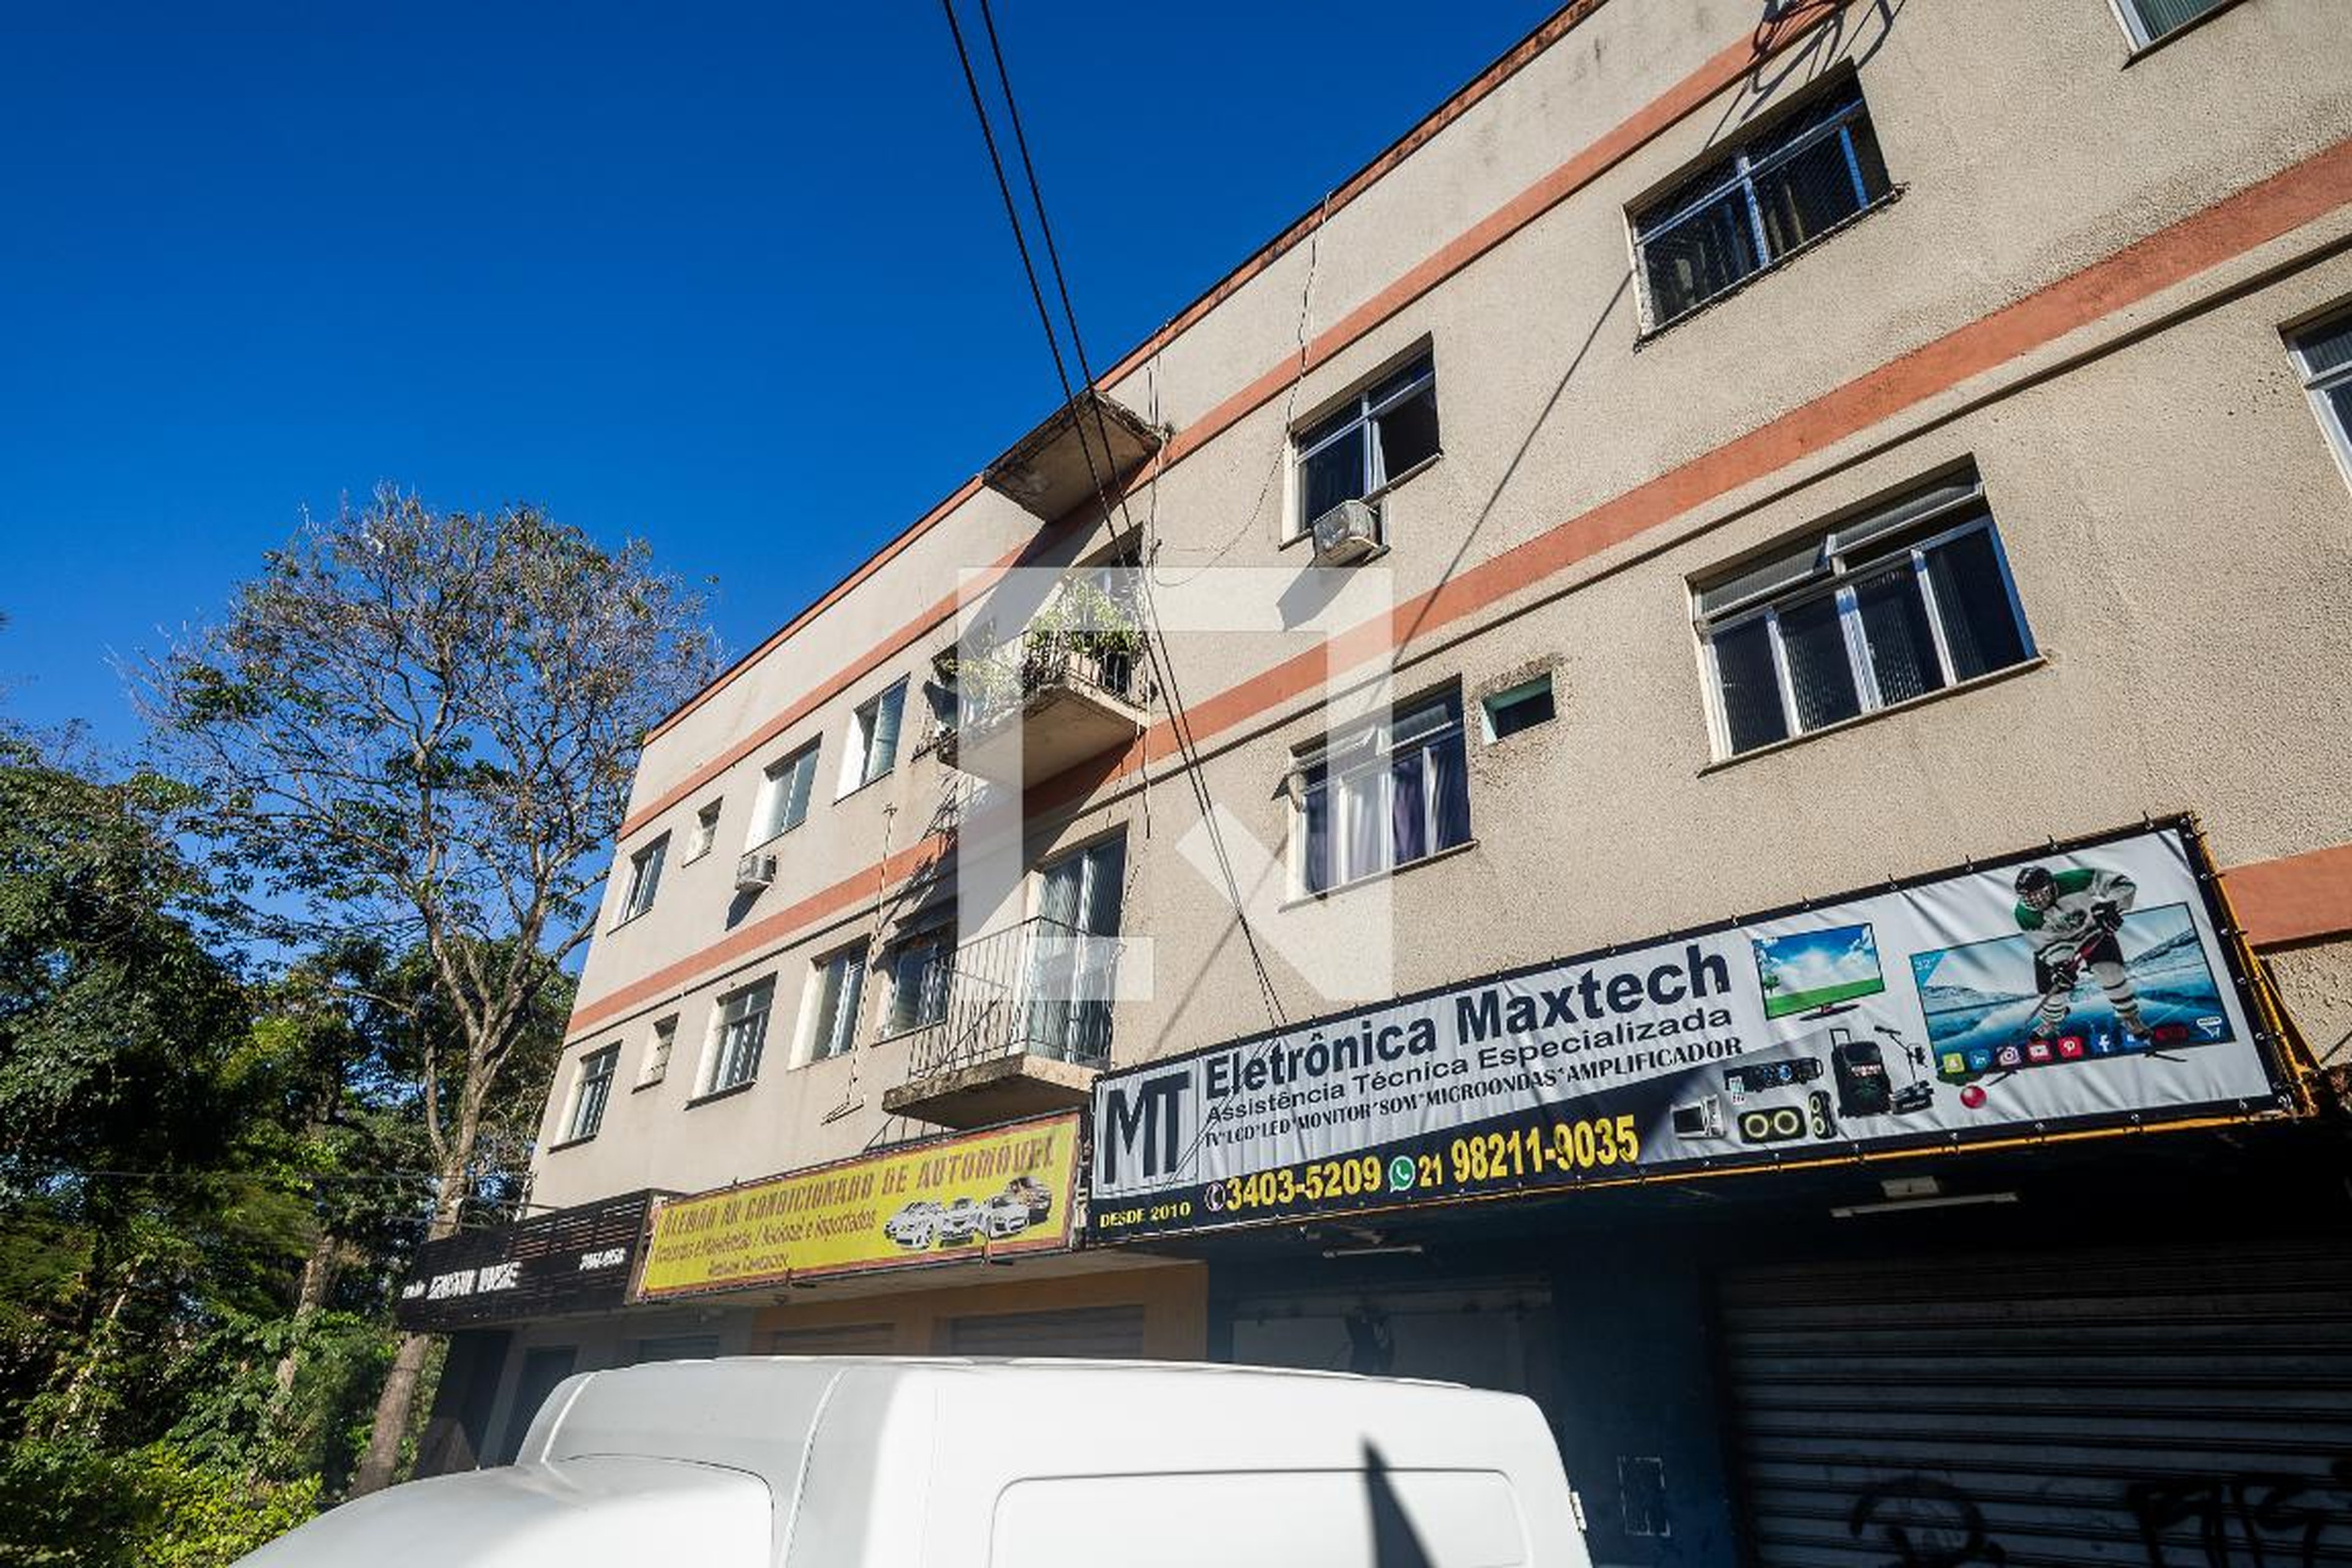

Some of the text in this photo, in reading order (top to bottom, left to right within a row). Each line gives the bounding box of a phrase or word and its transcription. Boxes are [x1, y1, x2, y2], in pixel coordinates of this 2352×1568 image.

[1206, 944, 1730, 1100] Eletrônica Maxtech
[1207, 1006, 1732, 1122] Assistência Técnica Especializada
[1104, 1071, 1191, 1185] MT
[1226, 1114, 1640, 1211] 3403-5209 21 98211-9035
[745, 1173, 875, 1221] CONDICIONADO
[883, 1166, 909, 1194] DE
[1100, 1201, 1191, 1228] DESDE 2010
